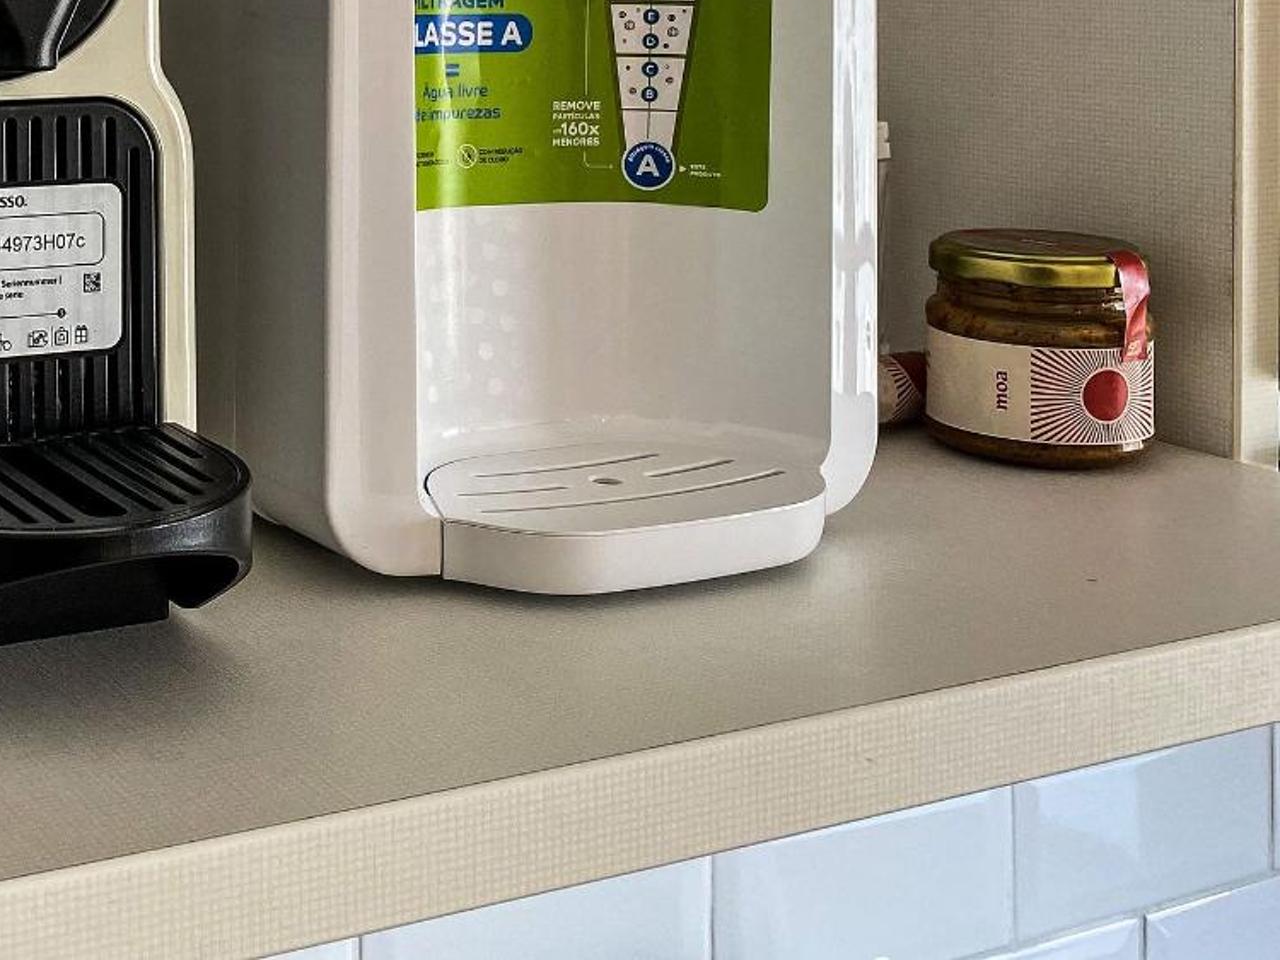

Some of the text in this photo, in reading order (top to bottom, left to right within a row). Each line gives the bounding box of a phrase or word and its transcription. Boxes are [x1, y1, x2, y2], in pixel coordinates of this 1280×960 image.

[415, 20, 523, 47] LASSE A
[458, 83, 488, 97] livre
[552, 101, 601, 111] REMOVE
[552, 137, 600, 147] MENORES
[635, 153, 660, 177] A
[996, 371, 1007, 410] moa
